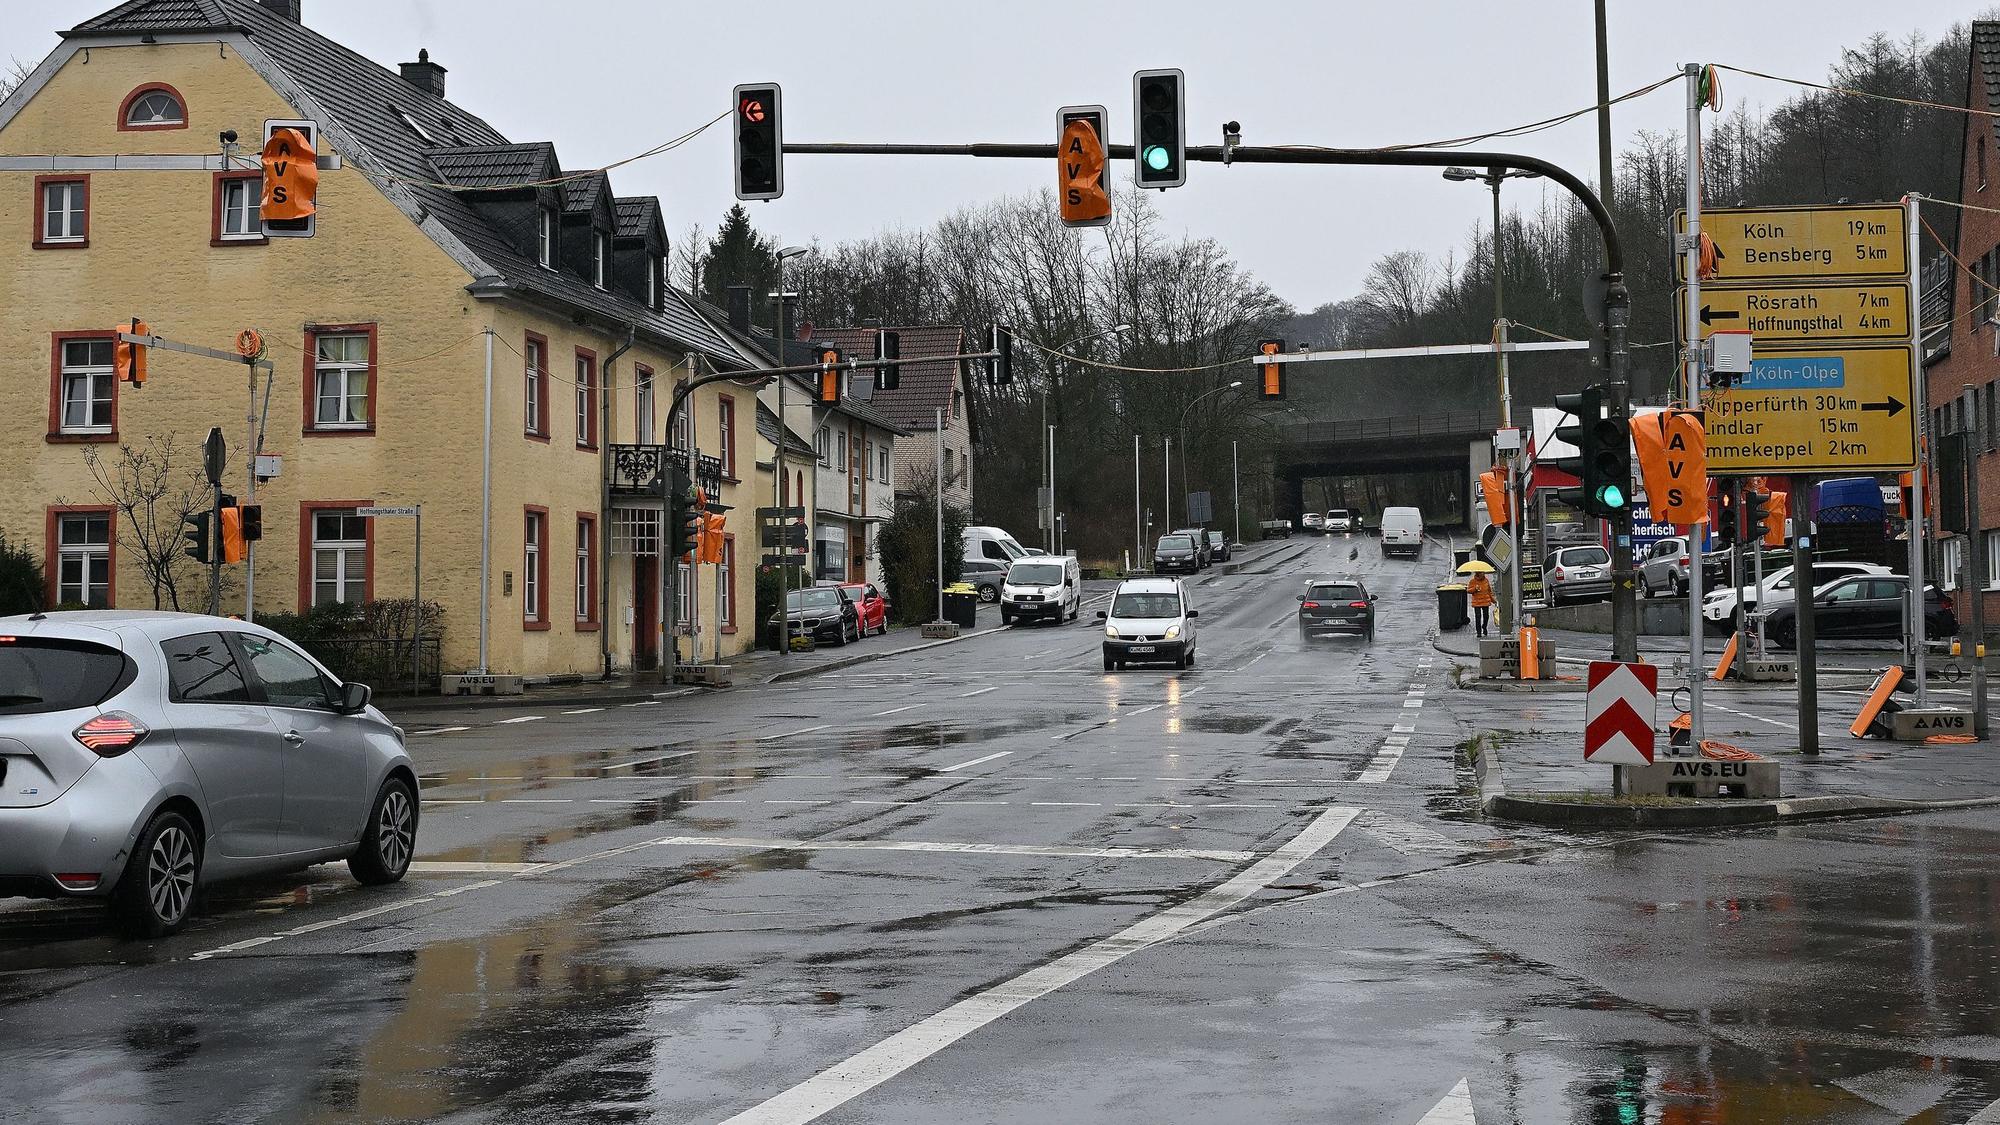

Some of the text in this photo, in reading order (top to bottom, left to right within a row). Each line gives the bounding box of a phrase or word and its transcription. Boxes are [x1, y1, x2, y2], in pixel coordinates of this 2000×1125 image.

[272, 142, 292, 203] AVS
[1067, 137, 1083, 206] AVS
[1744, 220, 1887, 239] Köln 19 km
[1745, 245, 1888, 264] Bensberg 5 km
[1747, 292, 1890, 310] Rösrath 7 km
[1749, 314, 1891, 334] Hoffnungsthal 4 km
[1755, 365, 1838, 382] Köln-Olpe
[1702, 396, 1857, 416] Wipperfürth 30 km
[1820, 418, 1836, 433] 15
[1840, 419, 1859, 433] km
[1706, 440, 1868, 460] mmekeppel 2 km
[1667, 432, 1686, 507] AVS
[1883, 490, 1900, 500] ruck
[1768, 664, 1789, 672] AVS
[460, 676, 495, 684] AVS.EU
[1932, 717, 1965, 729] AVS
[1672, 762, 1747, 777] AVS.EU
